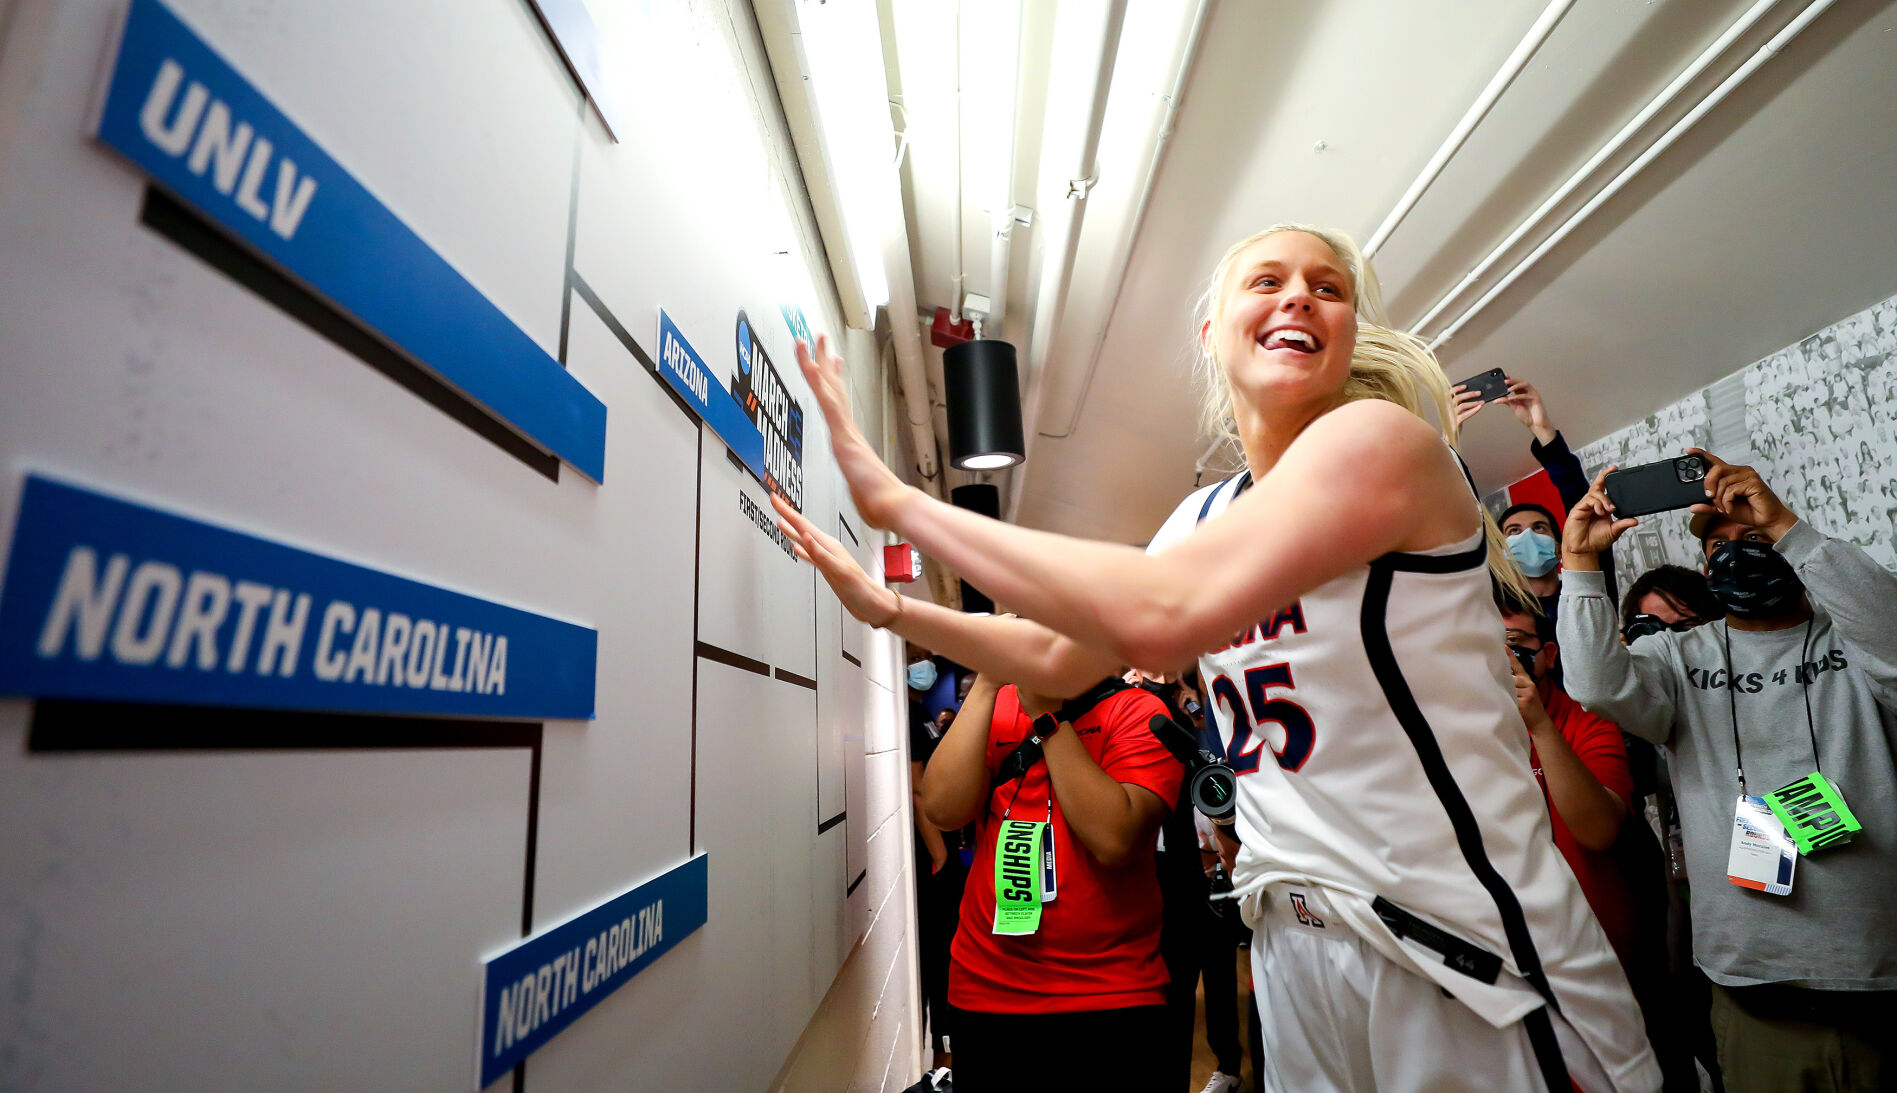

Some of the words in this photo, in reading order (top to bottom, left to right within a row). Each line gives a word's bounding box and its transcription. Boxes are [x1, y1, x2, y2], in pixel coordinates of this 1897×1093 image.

[140, 58, 317, 240] UNLV
[664, 331, 708, 407] ARIZONA
[751, 342, 788, 441] MARCH
[756, 406, 802, 510] MADNESS
[37, 546, 312, 676] NORTH
[313, 601, 508, 695] CAROLINA
[1212, 662, 1316, 776] 25
[1686, 664, 1764, 693] KICKS
[1772, 668, 1787, 685] 4
[495, 946, 580, 1057] NORTH
[582, 899, 663, 994] CAROLINA
